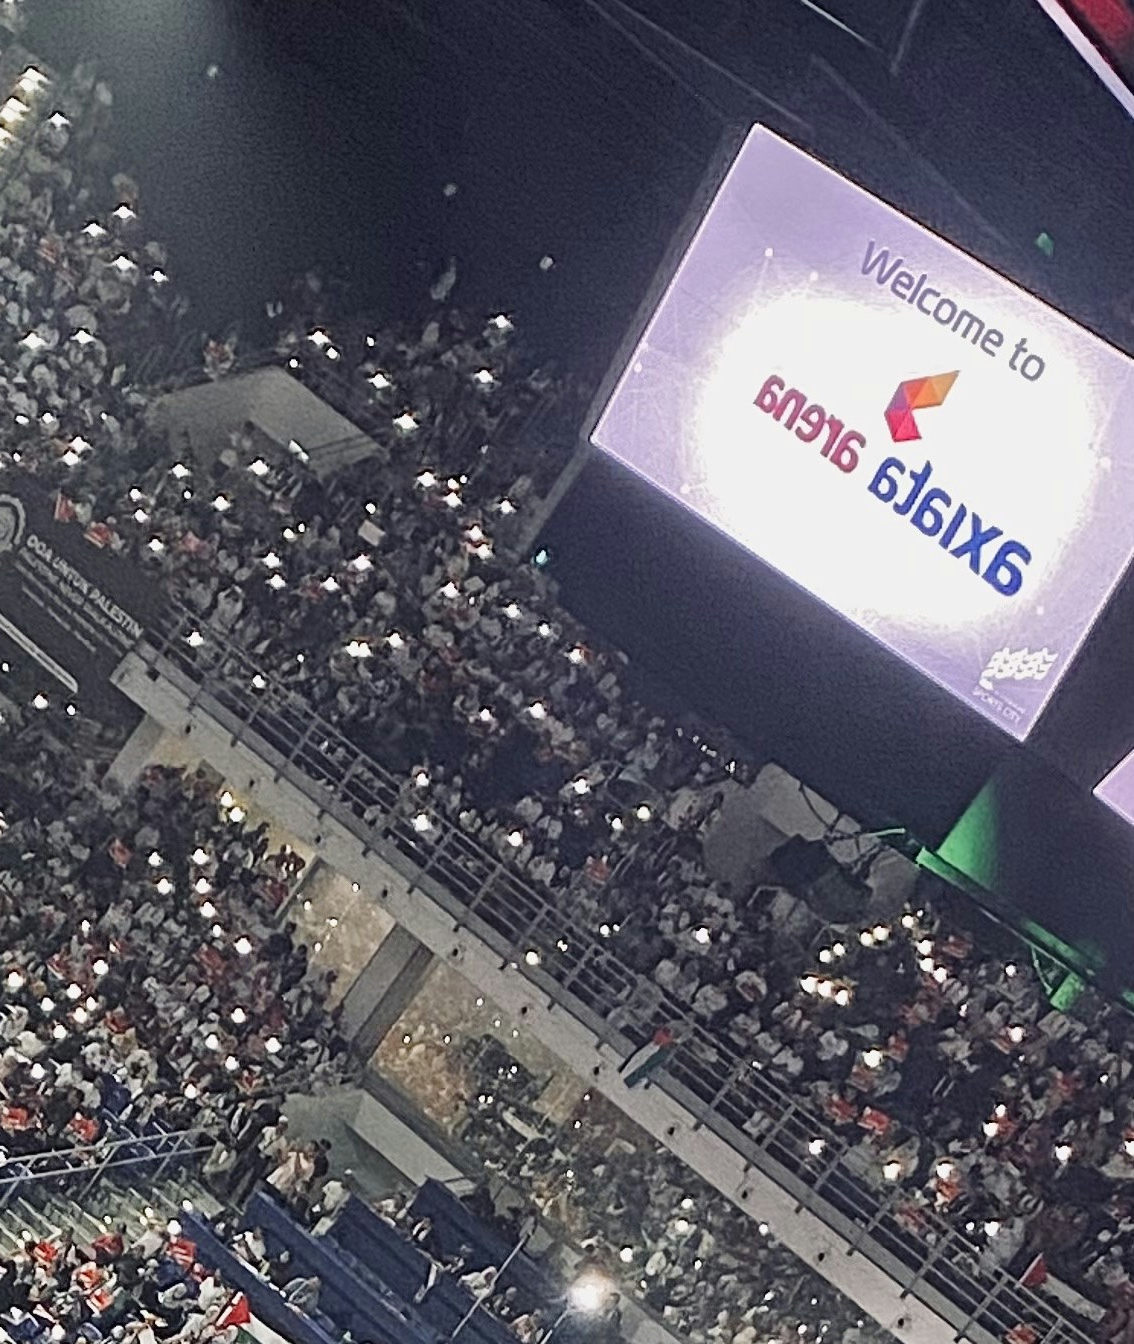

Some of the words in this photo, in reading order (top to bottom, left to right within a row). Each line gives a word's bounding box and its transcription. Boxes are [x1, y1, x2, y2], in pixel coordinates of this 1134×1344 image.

[860, 239, 1004, 358] Welcome
[1009, 338, 1047, 382] to
[89, 589, 144, 639] PALESTIN
